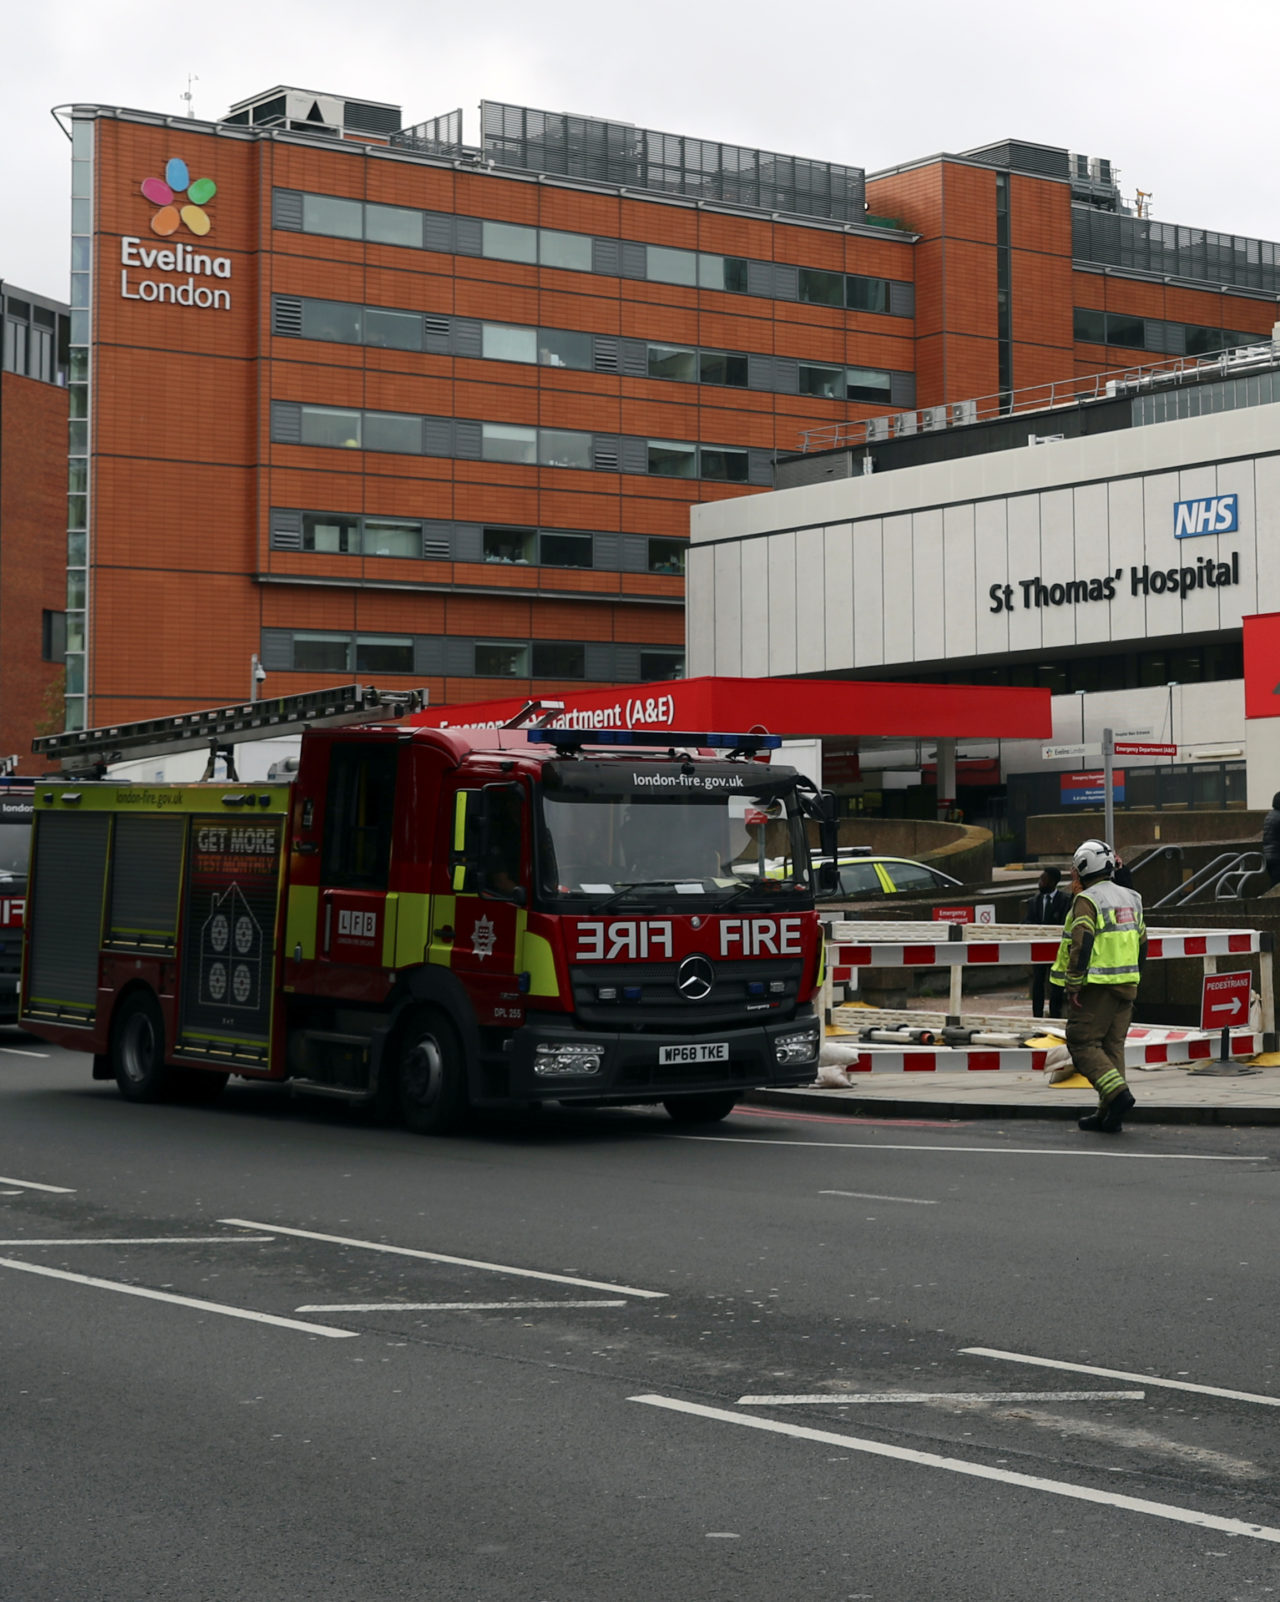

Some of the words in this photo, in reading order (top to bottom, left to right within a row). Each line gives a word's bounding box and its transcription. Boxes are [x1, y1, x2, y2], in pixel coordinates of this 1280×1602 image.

[121, 236, 231, 278] Evelina
[121, 269, 231, 310] London
[1174, 497, 1234, 536] NHS
[989, 583, 1014, 614] St
[1130, 551, 1239, 599] Hospital
[527, 704, 622, 729] artment
[626, 694, 674, 729] (A&E)
[1116, 745, 1139, 754] Emergency
[1139, 746, 1164, 754] Department
[632, 772, 744, 790] london-fire.gov.uk
[116, 788, 184, 809] london-fire.gov.uk
[198, 827, 228, 852] GET
[230, 828, 275, 853] MORE
[719, 918, 802, 956] FIRE
[1207, 979, 1248, 990] PEDESTRIANS
[664, 1047, 697, 1062] WP68
[700, 1045, 724, 1060] TKE
